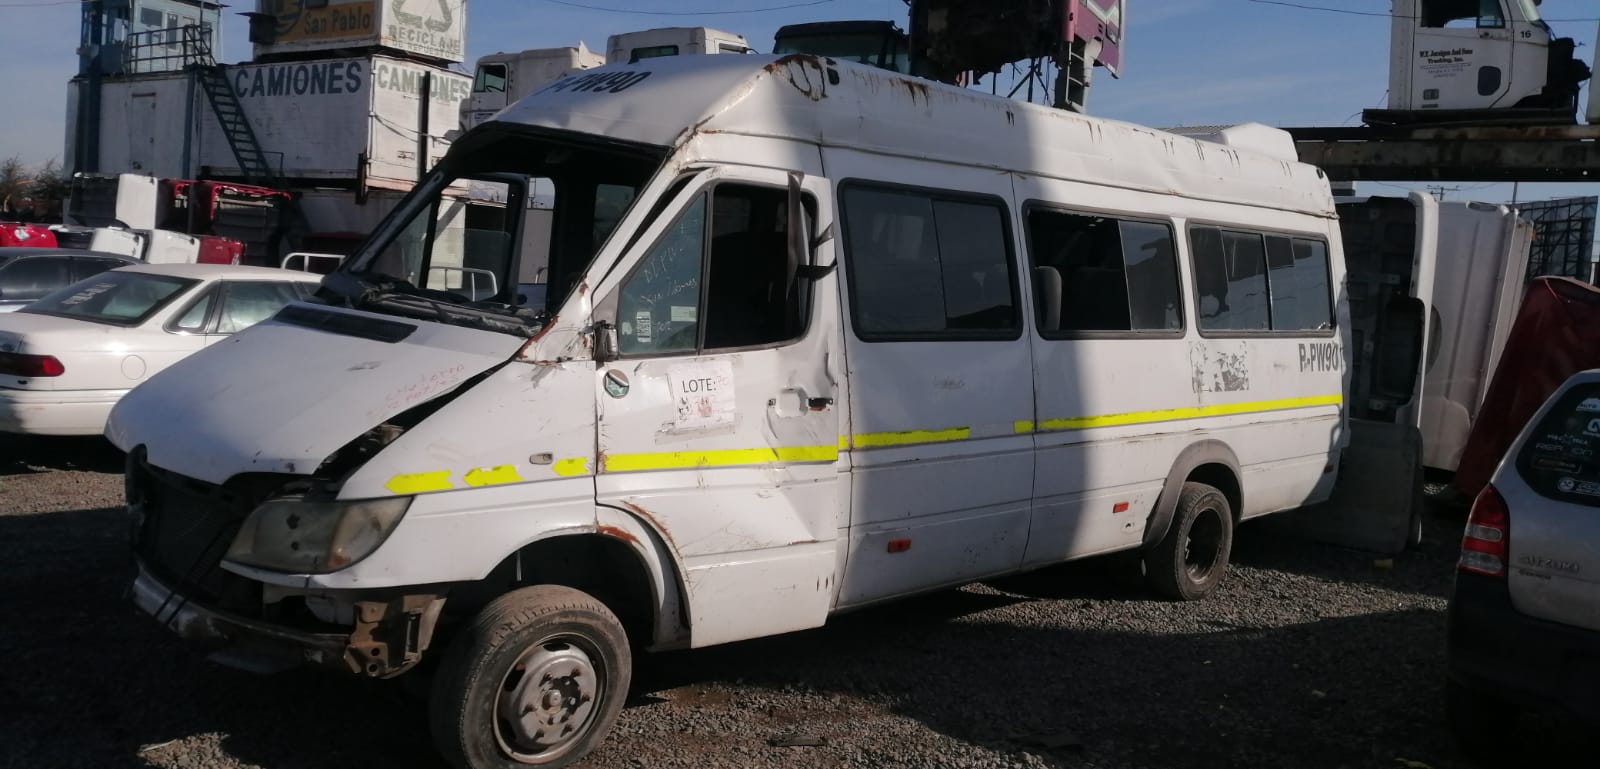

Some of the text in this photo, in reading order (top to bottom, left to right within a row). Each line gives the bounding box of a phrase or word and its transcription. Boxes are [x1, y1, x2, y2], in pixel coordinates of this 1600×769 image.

[304, 6, 371, 35] San Pablo
[388, 24, 461, 49] RECICLAJE
[1520, 30, 1532, 39] 16
[234, 61, 362, 98] CAMIONES
[682, 378, 717, 393] LOTE:
